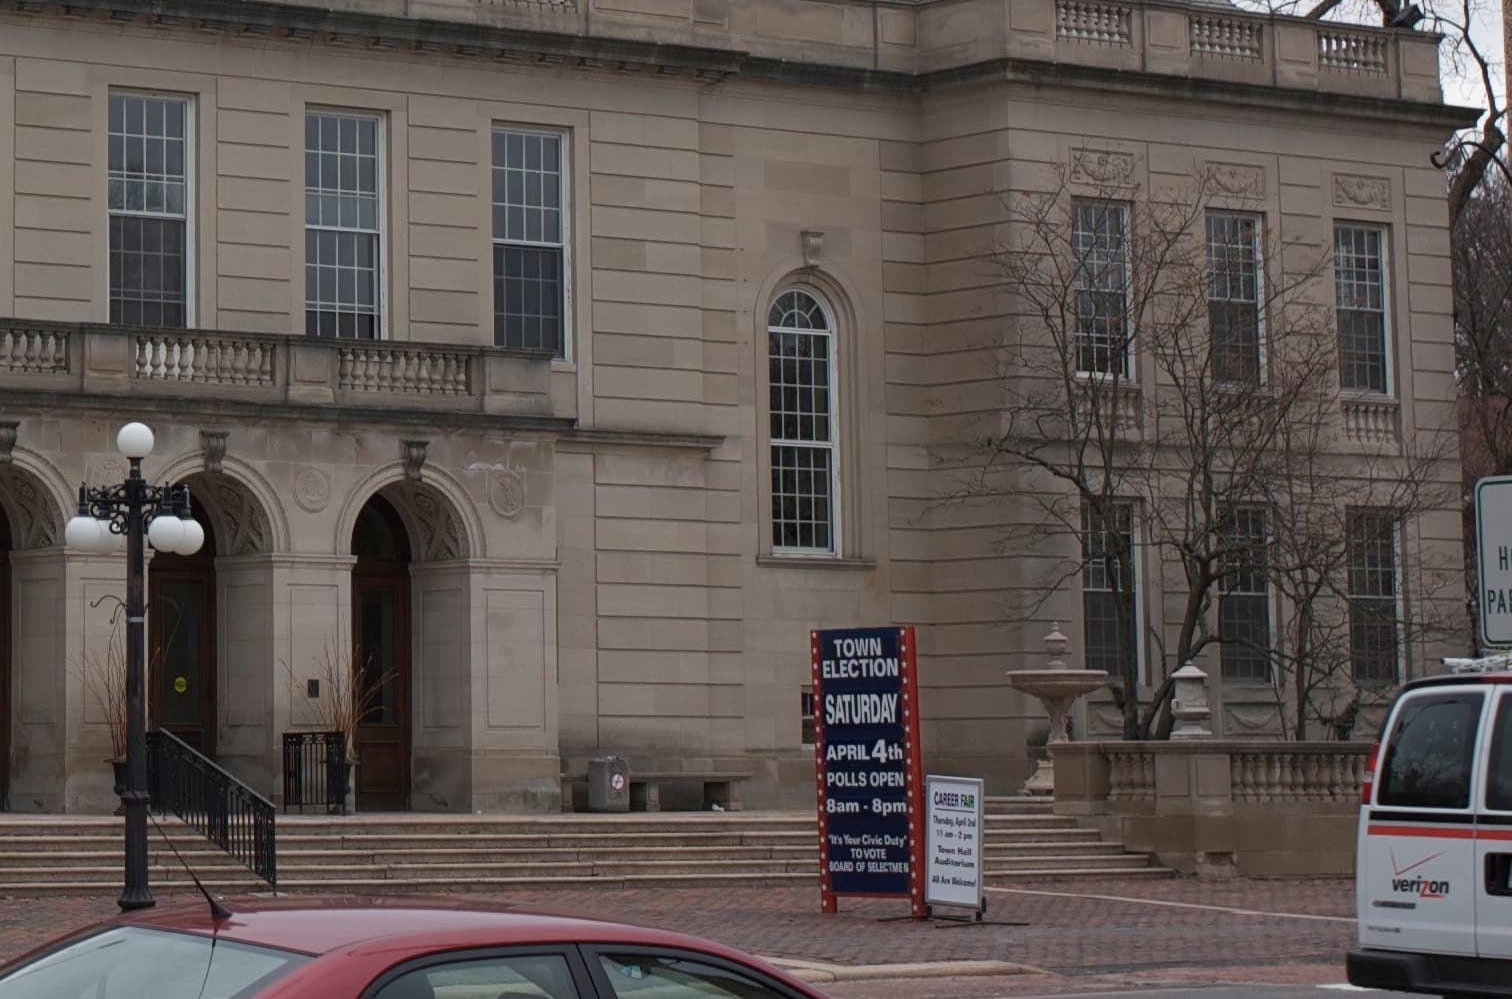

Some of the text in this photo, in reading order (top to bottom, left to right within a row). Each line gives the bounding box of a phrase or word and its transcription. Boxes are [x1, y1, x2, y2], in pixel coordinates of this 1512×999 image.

[1498, 546, 1512, 571] H
[833, 637, 882, 657] TOWN
[822, 658, 899, 678] ELECTION
[825, 693, 898, 725] SATURDAY
[826, 739, 904, 763] APRIL 4th
[827, 771, 905, 787] POLLS OPEN
[826, 798, 860, 813] 8am
[872, 797, 907, 817] 8pm
[934, 792, 975, 809] CAREER FAIR
[843, 834, 861, 846] Your
[861, 834, 883, 846] Civic
[850, 848, 887, 860] TO VOTE
[934, 856, 975, 868] Auditorium
[829, 861, 909, 874] BOARD OF SELECTMEN
[1392, 875, 1450, 898] verizon
